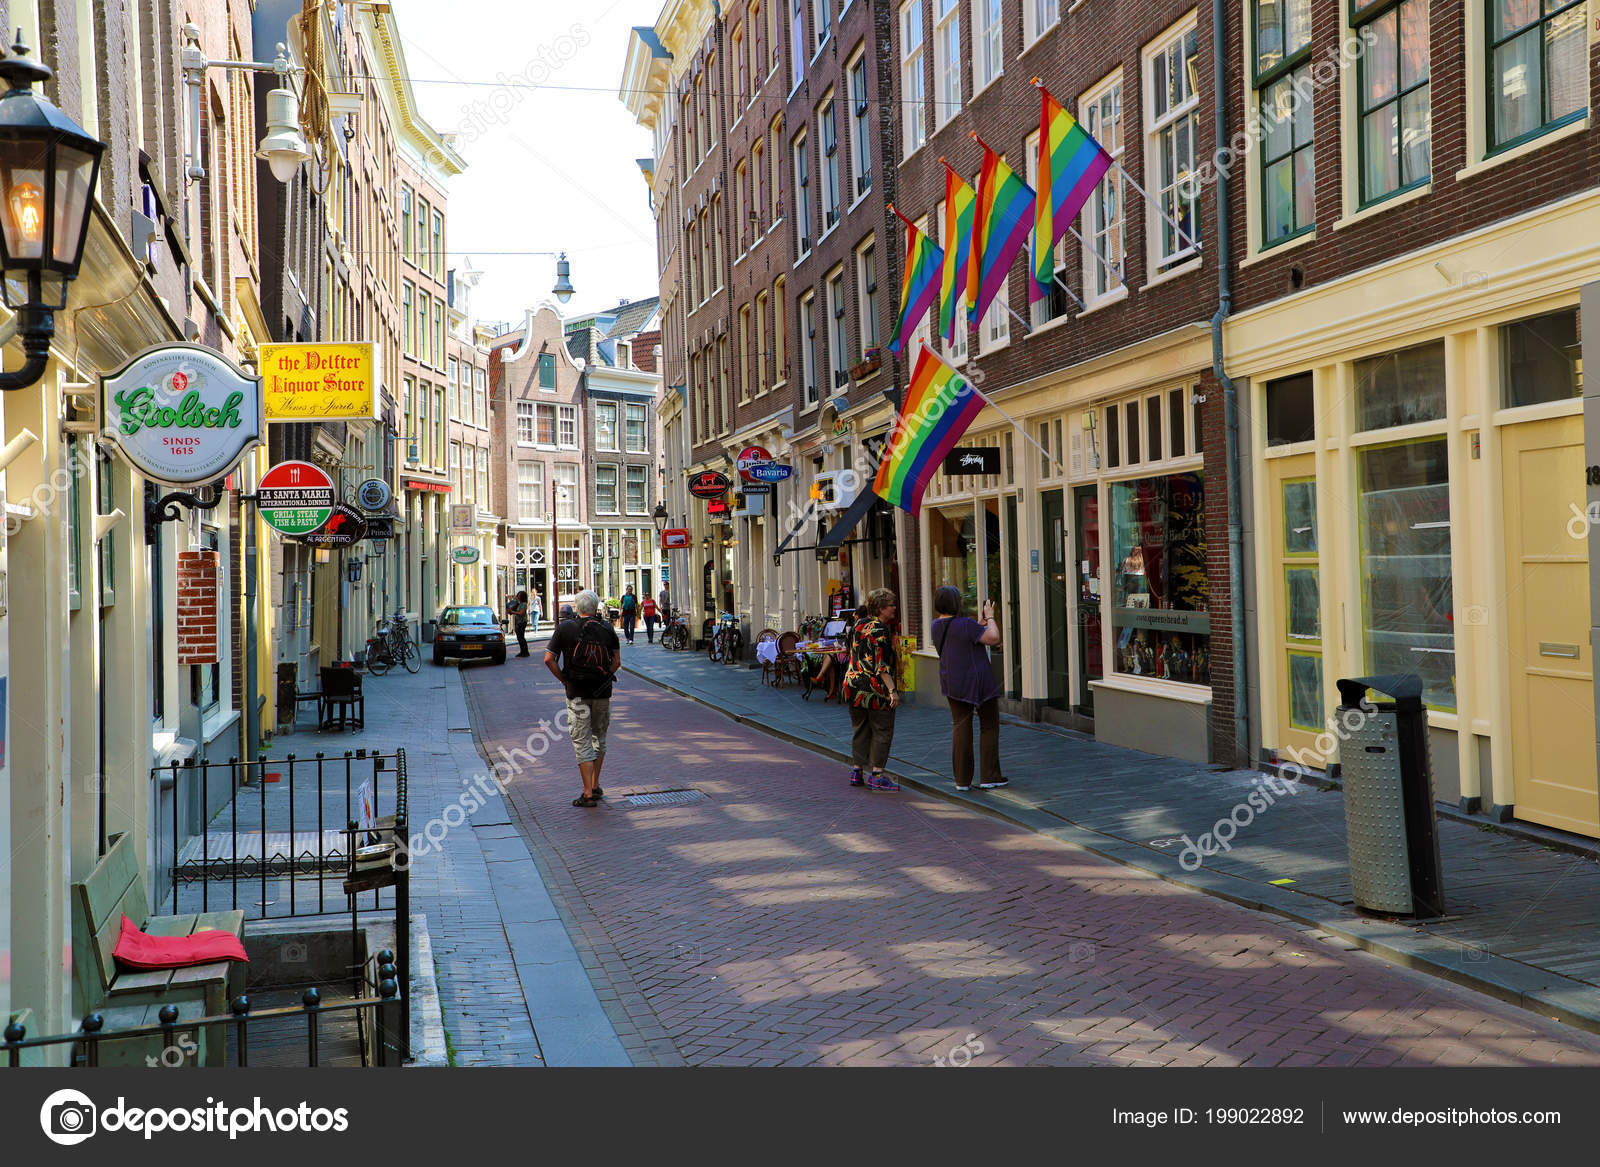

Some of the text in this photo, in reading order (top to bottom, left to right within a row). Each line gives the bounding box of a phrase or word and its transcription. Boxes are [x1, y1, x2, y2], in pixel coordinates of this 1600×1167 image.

[279, 351, 360, 372] the Delfter
[271, 371, 365, 394] Liquor Store
[114, 387, 244, 435] Grolsch
[162, 437, 201, 446] SINDS
[756, 469, 788, 477] Bavaria
[260, 490, 331, 499] LA SANTA MARIA
[273, 510, 319, 519] GRILL STEAK
[274, 519, 289, 527] FISH
[297, 518, 318, 527] PASTA
